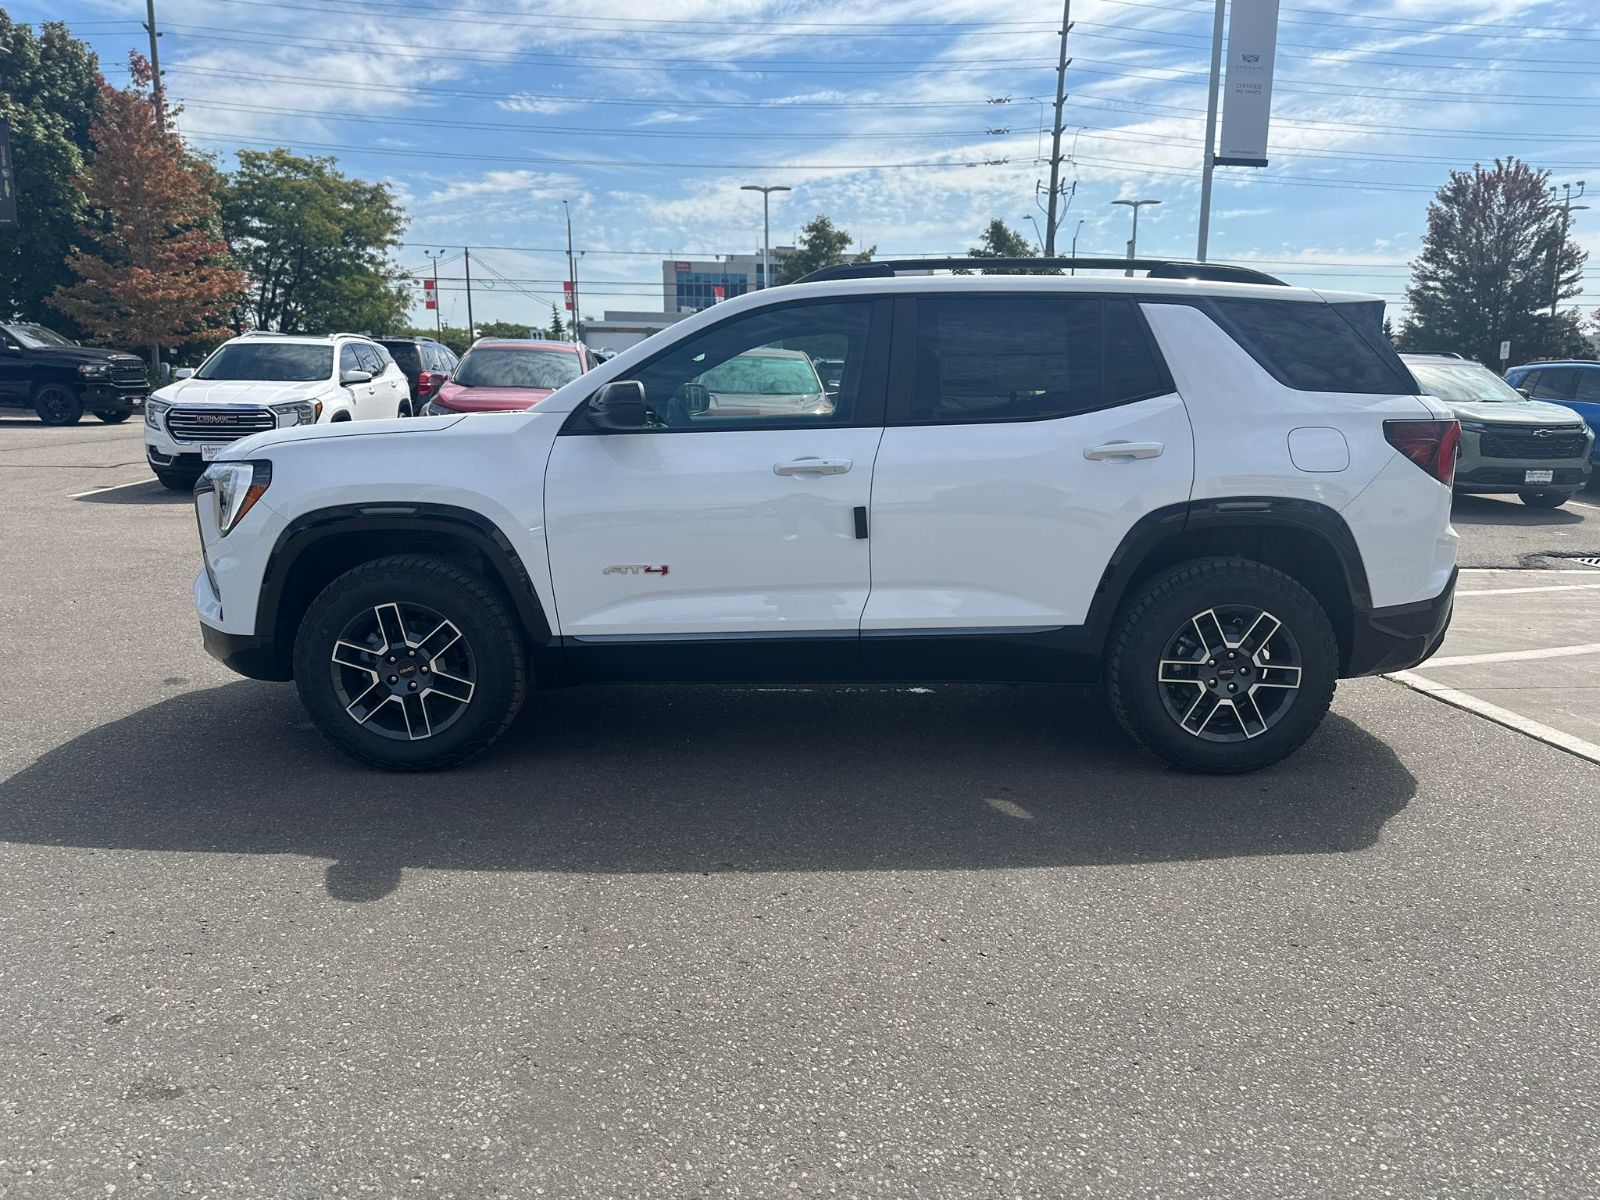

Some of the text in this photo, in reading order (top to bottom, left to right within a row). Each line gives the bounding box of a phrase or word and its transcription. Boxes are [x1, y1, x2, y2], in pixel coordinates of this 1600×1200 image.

[197, 415, 237, 423] GMC
[602, 564, 669, 576] AT4
[400, 665, 415, 673] GMC
